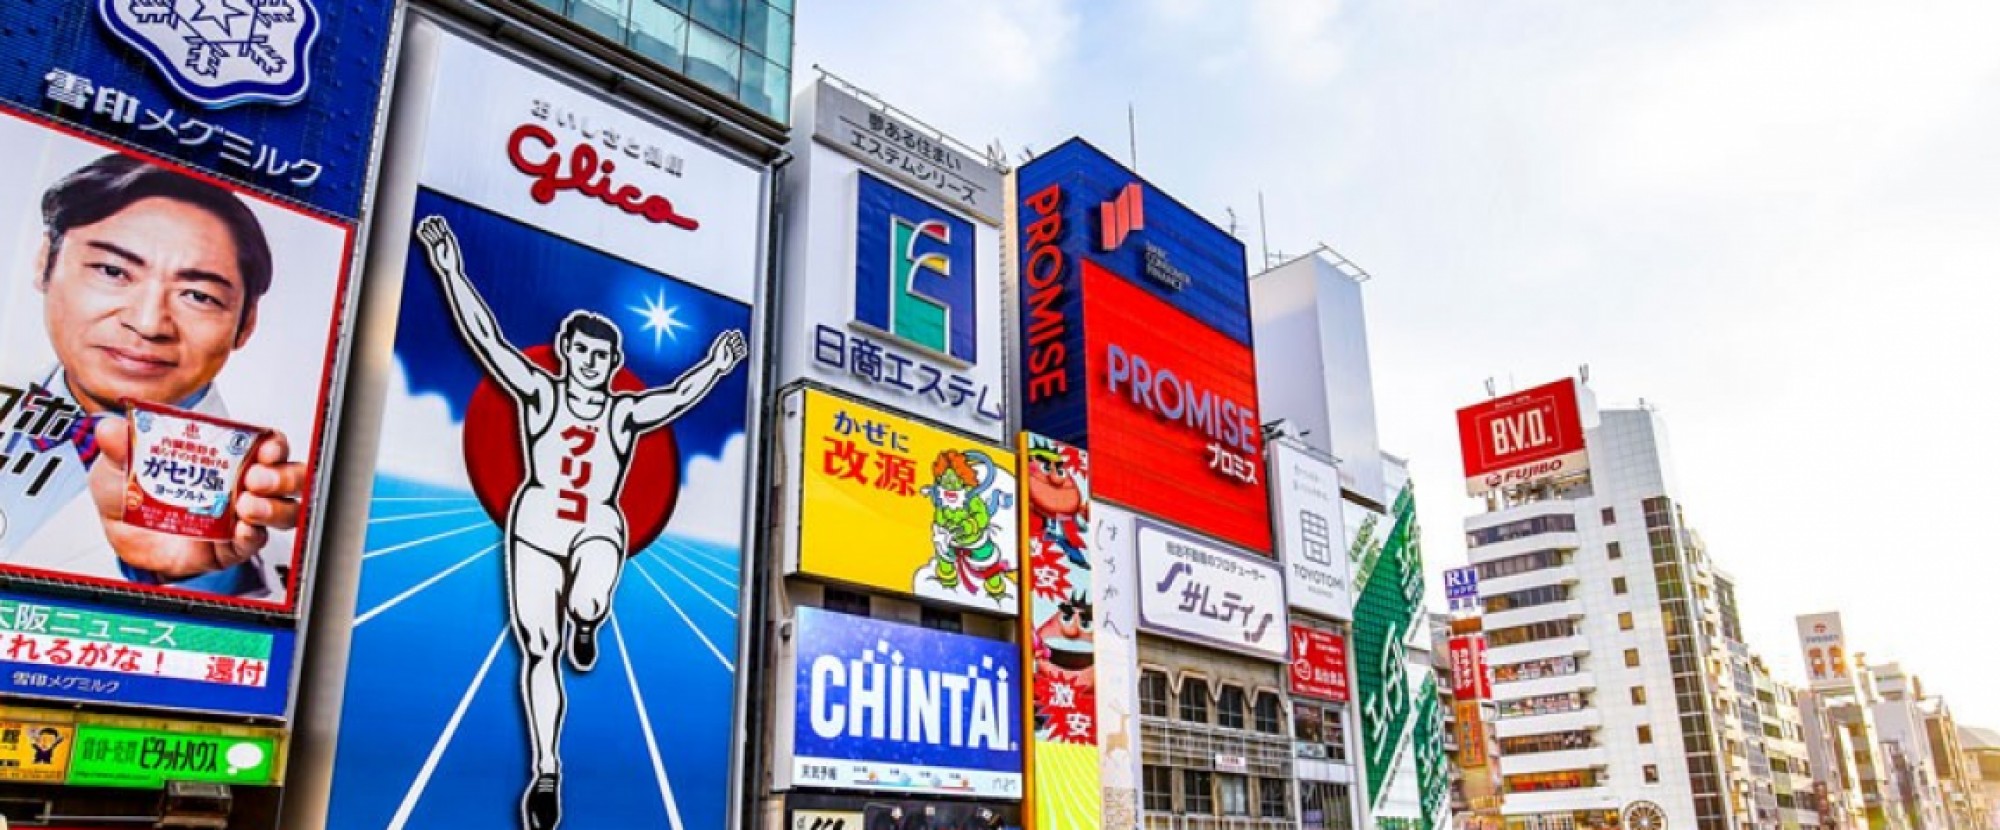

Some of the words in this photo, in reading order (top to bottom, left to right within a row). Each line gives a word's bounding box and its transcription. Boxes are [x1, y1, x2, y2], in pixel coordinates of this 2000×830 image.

[45, 67, 322, 187] 雪印メグミルク
[507, 123, 699, 232] Glico
[1024, 183, 1067, 403] PROMISE
[815, 323, 1005, 422] 日商エステム
[1107, 343, 1258, 455] PROMISE
[557, 425, 599, 524] グリコ
[822, 436, 917, 497] 改源
[834, 410, 910, 453] かぜに
[1206, 442, 1258, 485] プロミス
[1490, 408, 1553, 456] B.V.D.
[1178, 580, 1254, 627] サムティ
[0, 632, 165, 674] れるがな！
[205, 656, 265, 687] 還付
[810, 645, 1009, 751] CHINTAI
